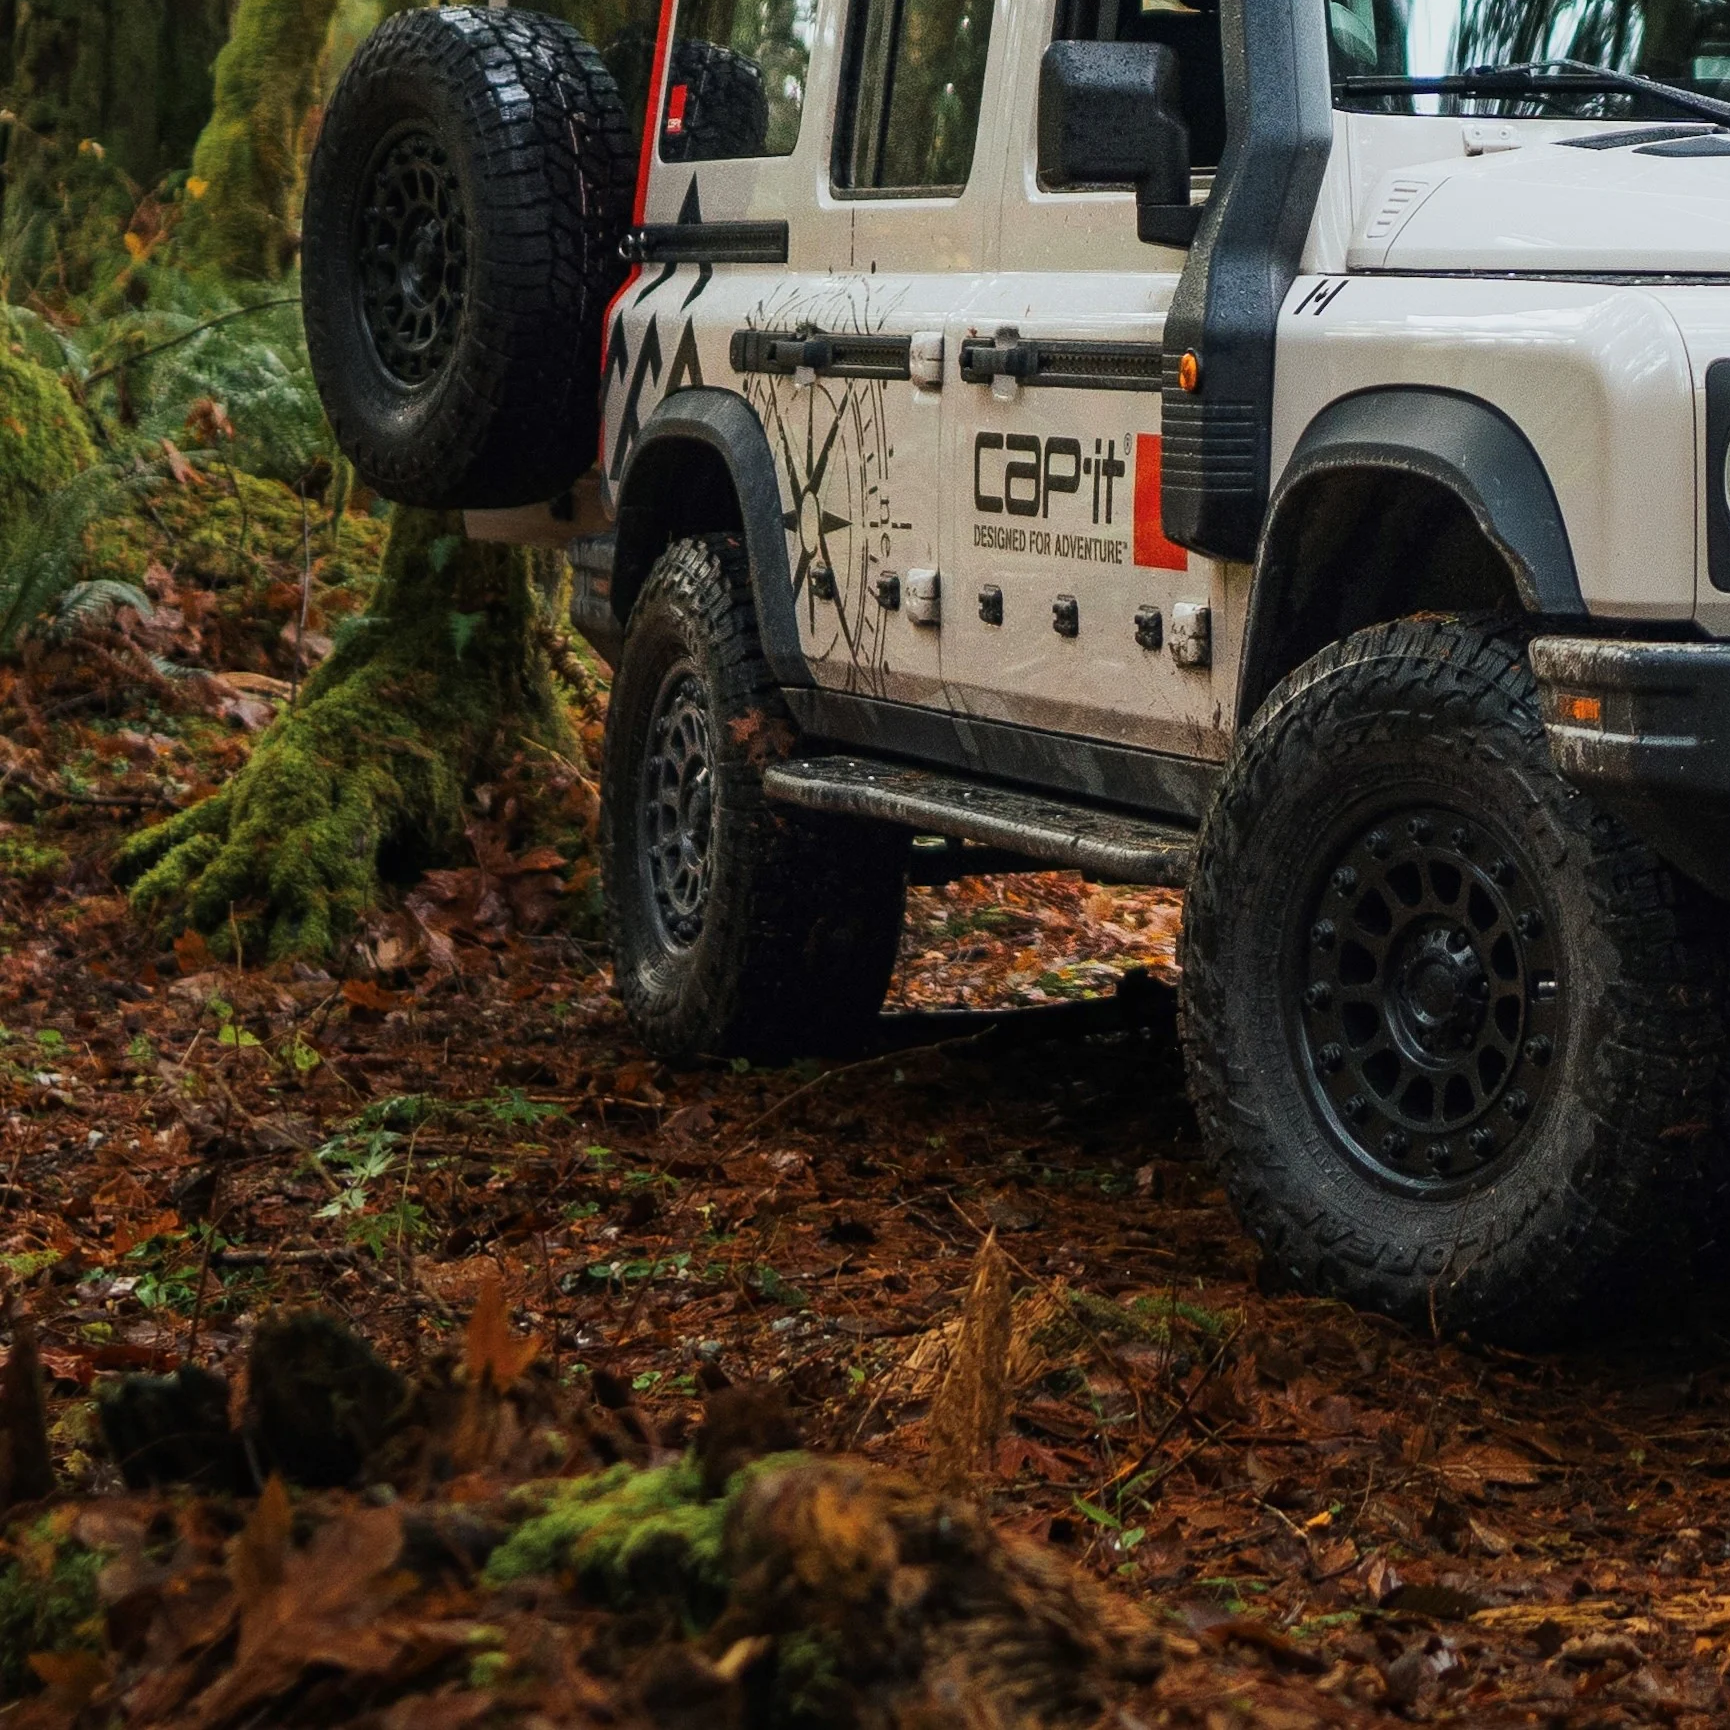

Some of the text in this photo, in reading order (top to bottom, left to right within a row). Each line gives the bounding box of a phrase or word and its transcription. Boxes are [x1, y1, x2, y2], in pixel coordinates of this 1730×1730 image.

[973, 524, 1123, 564] DESIGNED FOR ADVENTURE
